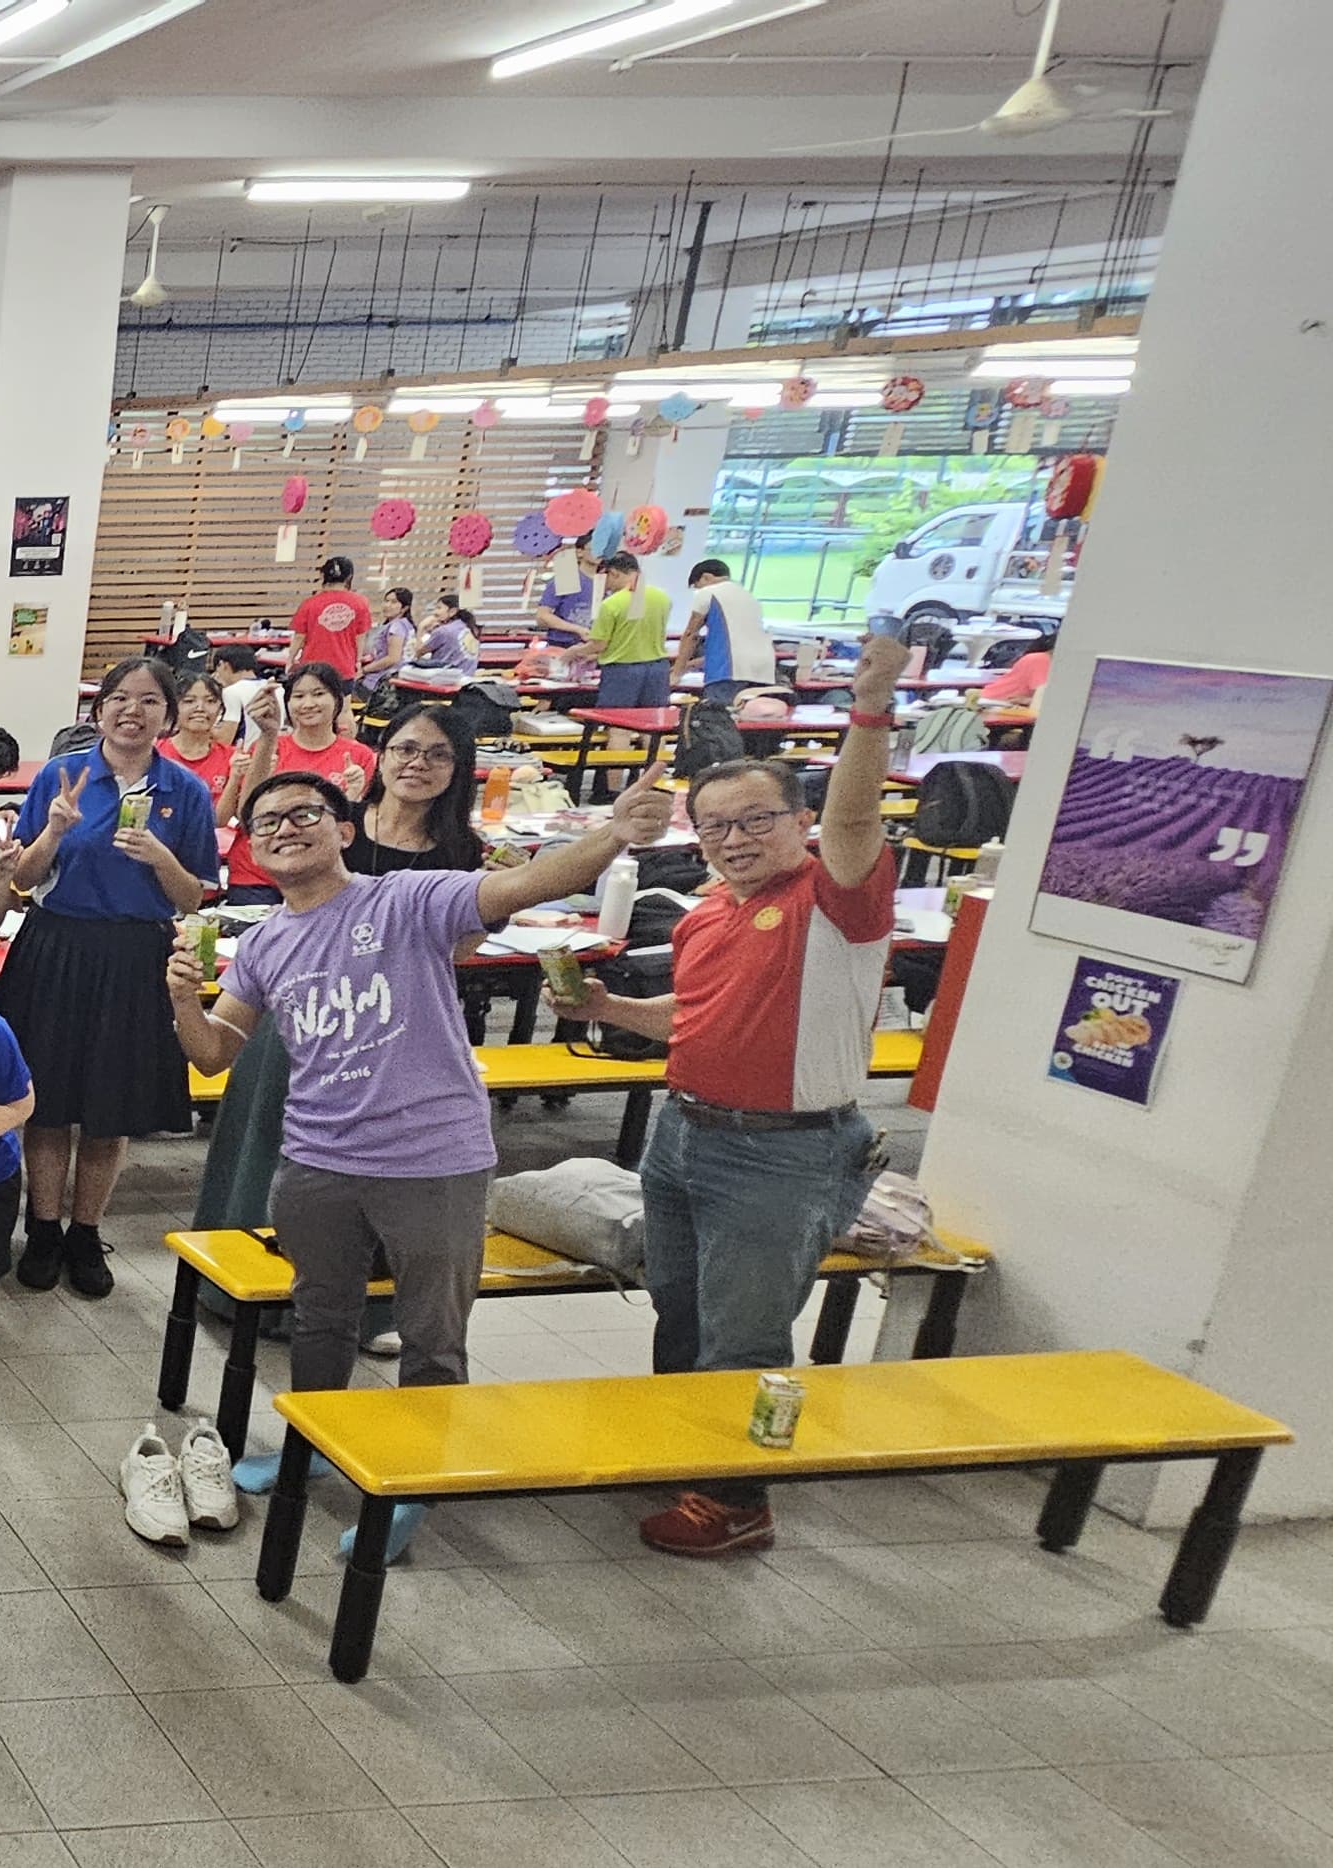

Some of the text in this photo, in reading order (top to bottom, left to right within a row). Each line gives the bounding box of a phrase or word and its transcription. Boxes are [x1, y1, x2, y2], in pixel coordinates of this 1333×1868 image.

[1084, 976, 1162, 1004] CHICKEN
[1090, 991, 1151, 1017] OUT
[340, 1065, 373, 1081] 2016
